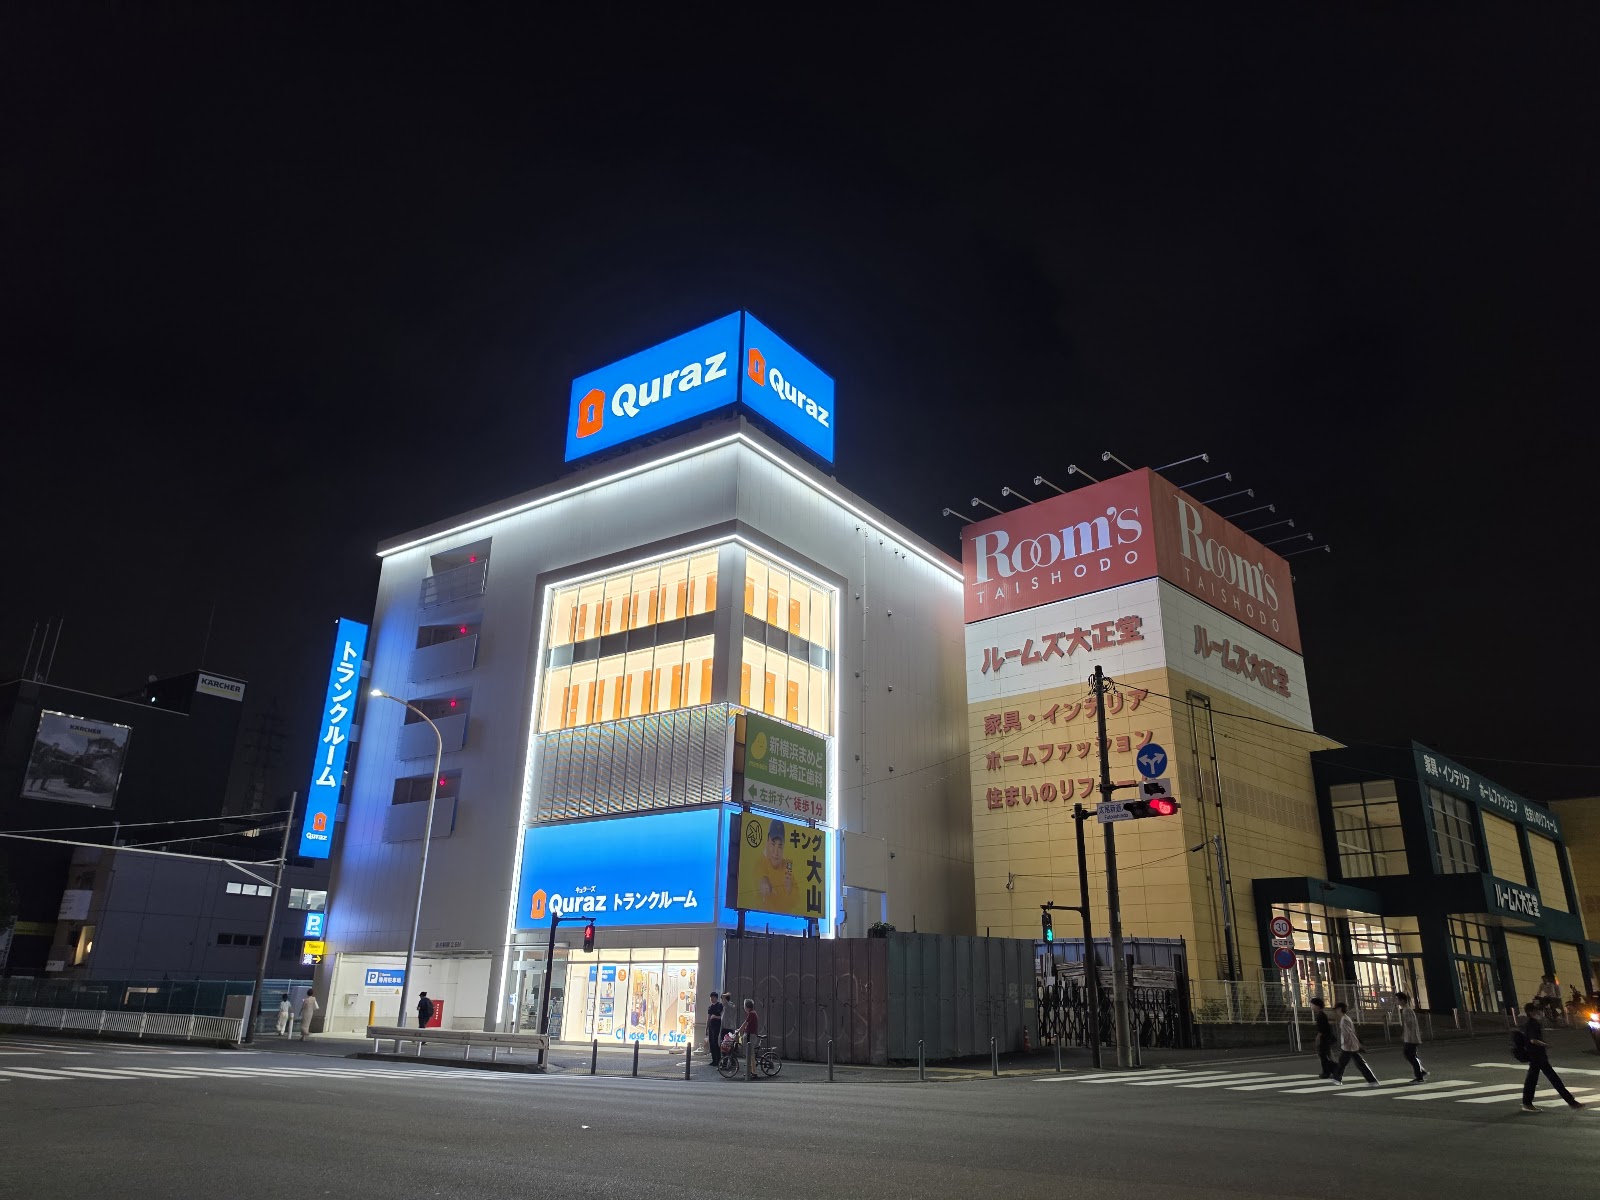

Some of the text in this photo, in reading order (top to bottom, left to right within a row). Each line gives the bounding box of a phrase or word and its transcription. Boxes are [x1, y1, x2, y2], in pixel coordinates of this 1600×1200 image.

[612, 351, 727, 418] Quraz
[769, 368, 829, 428] Quraz
[970, 506, 1142, 586] Room's
[1173, 494, 1279, 612] Room's
[977, 551, 1138, 604] TAISHODO
[1185, 567, 1280, 633] TAISHODO
[981, 615, 1144, 674] ルームズ大正堂
[316, 641, 357, 787] トランクルーム
[769, 736, 823, 769] 新横浜まめど
[305, 832, 328, 841] Quraz
[794, 797, 823, 817] 徒歩1分
[790, 830, 822, 852] キング
[549, 890, 698, 917] Quraz トランクルーム
[806, 855, 822, 914] 大山
[1275, 922, 1288, 932] 30
